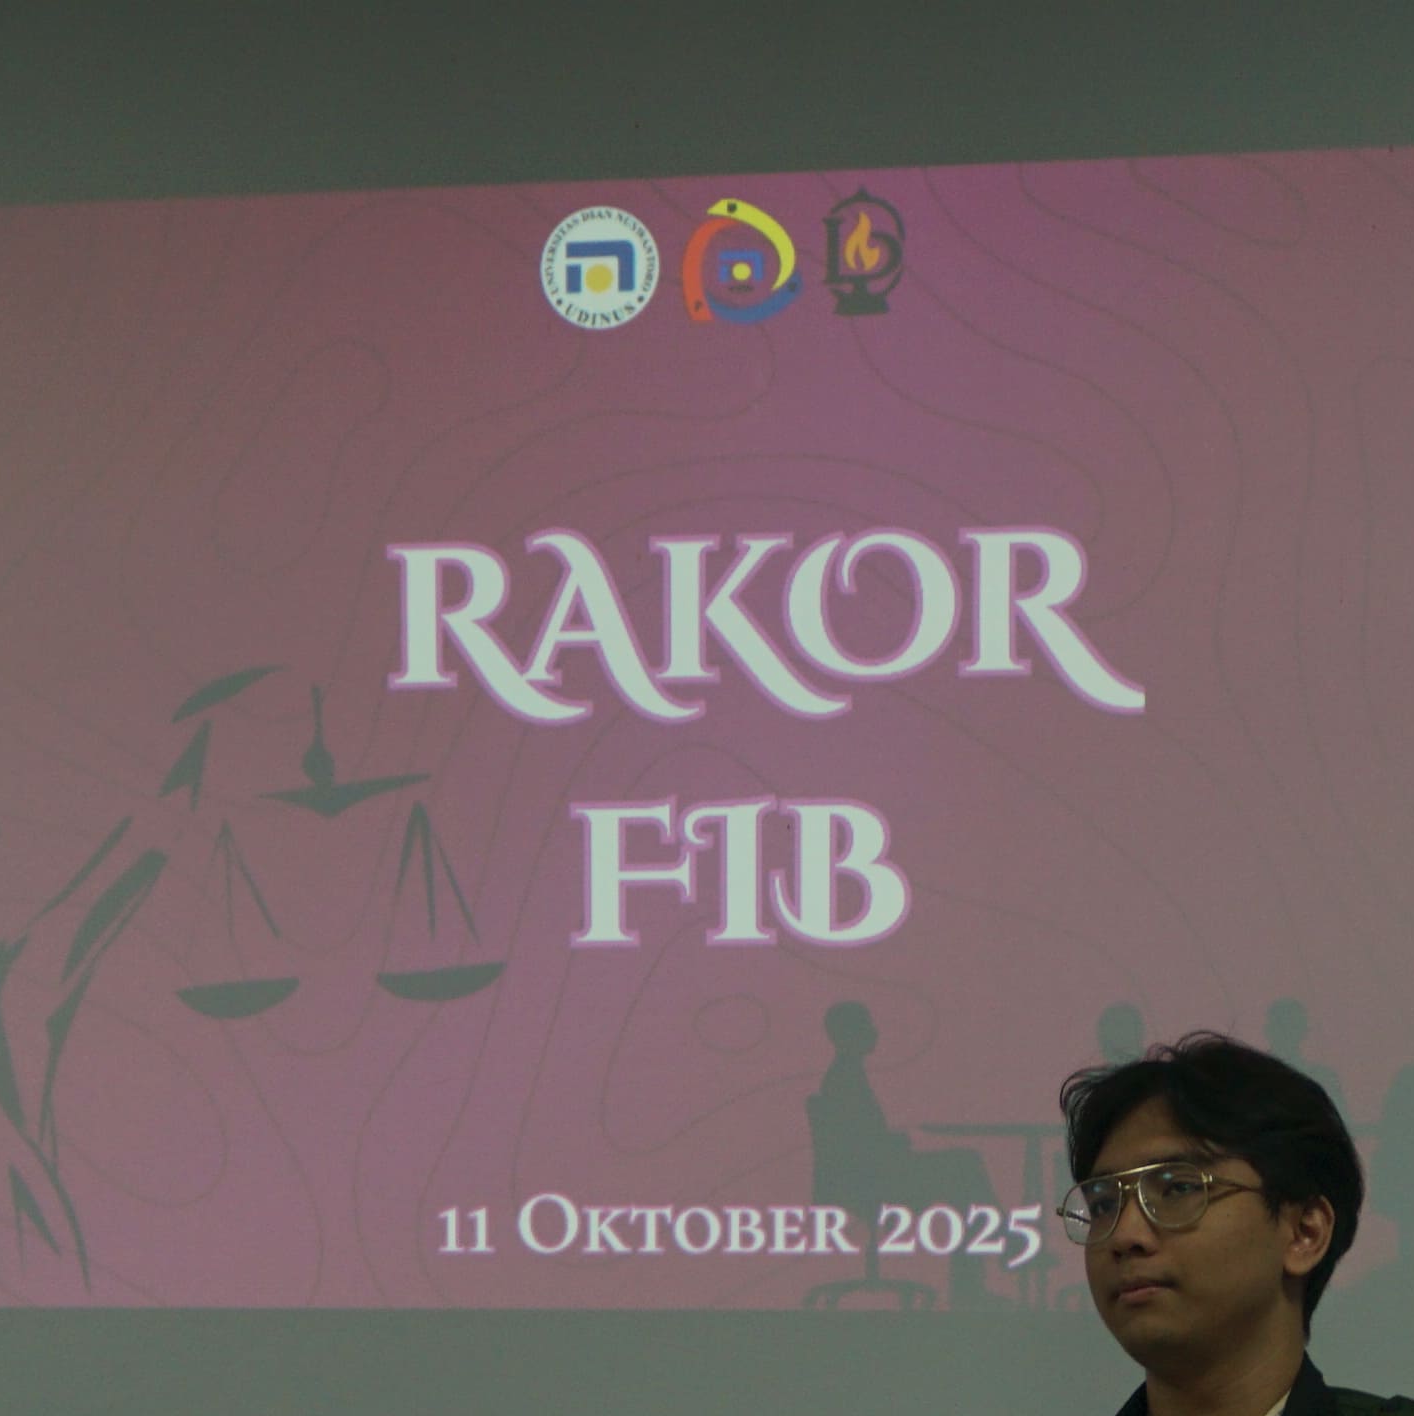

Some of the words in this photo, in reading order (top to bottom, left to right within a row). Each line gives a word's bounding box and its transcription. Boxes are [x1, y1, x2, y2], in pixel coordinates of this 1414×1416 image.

[580, 208, 614, 222] DIAN
[565, 302, 637, 326] UDINUS
[389, 526, 1145, 723] RAKOR
[570, 793, 911, 948] FIB
[438, 1206, 494, 1254] 11
[877, 1203, 1042, 1268] 2025
